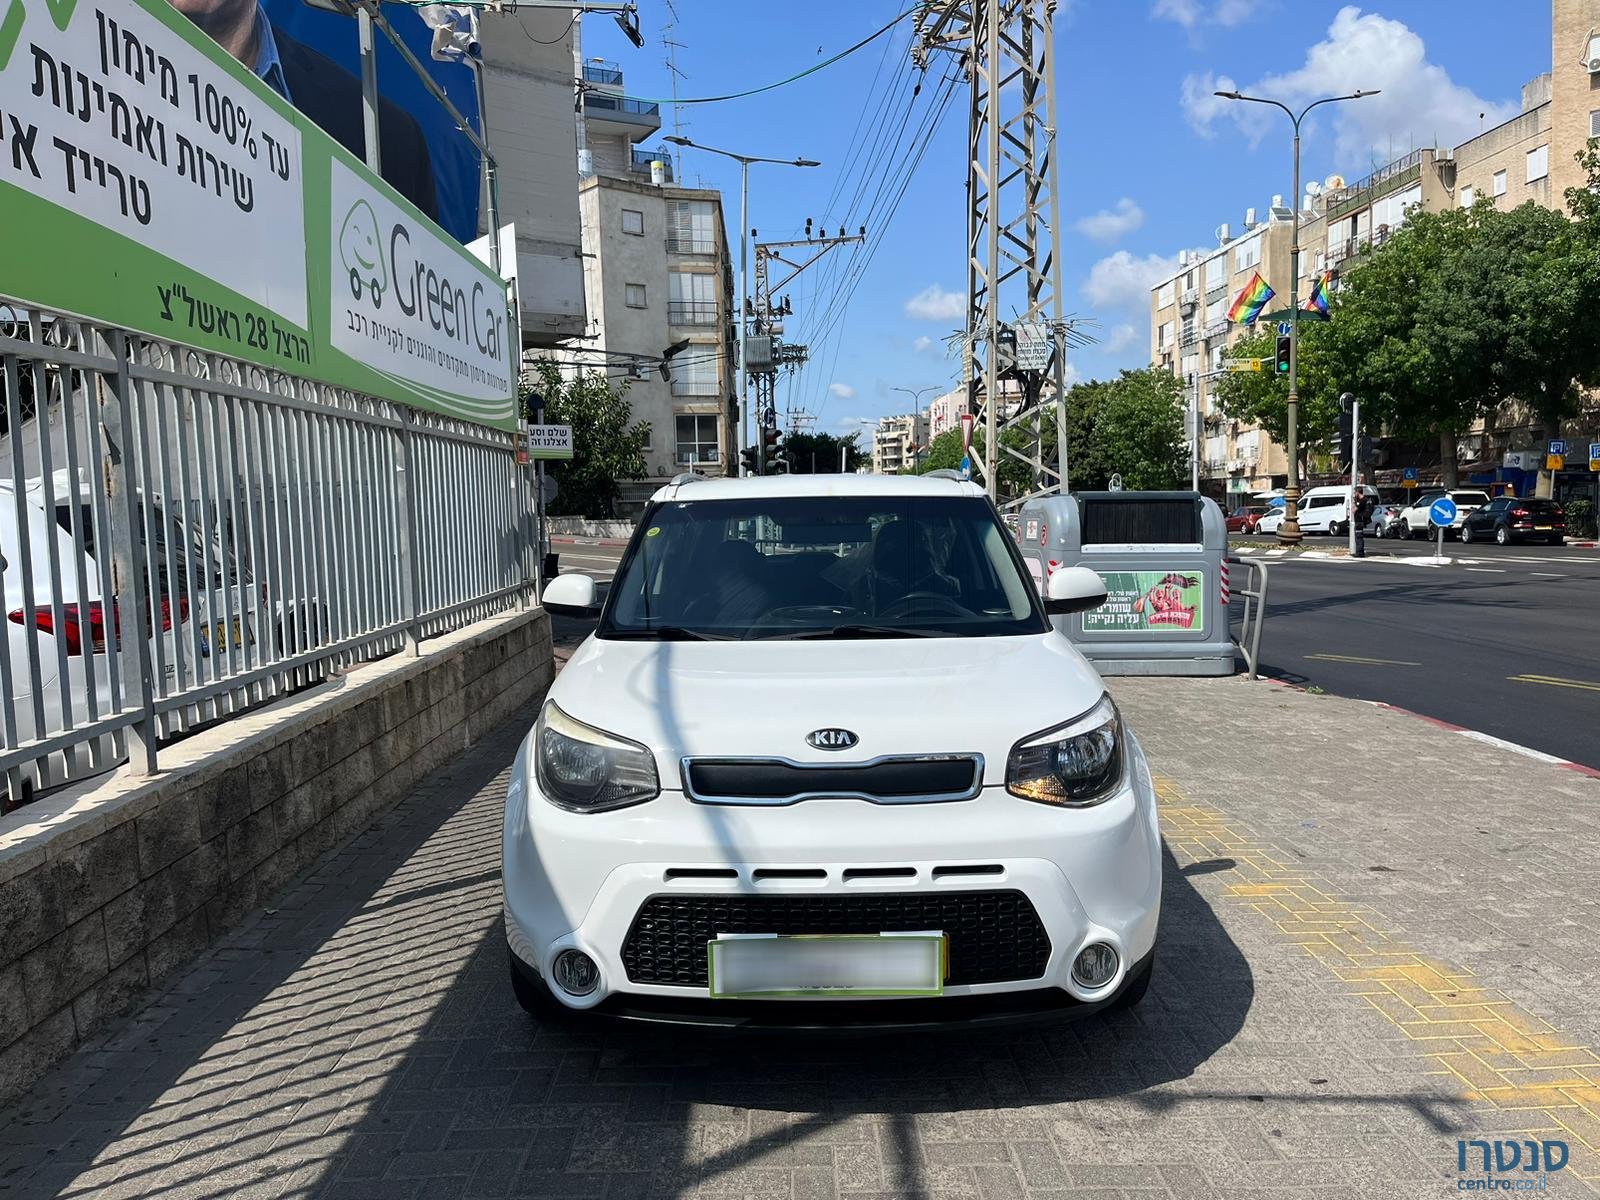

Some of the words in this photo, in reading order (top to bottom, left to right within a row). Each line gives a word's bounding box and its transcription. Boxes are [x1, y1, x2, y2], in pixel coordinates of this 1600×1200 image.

[96, 8, 179, 108] מימון
[30, 43, 168, 167] ואמינות
[188, 74, 257, 160] 100%
[176, 133, 254, 213] שירות
[262, 131, 290, 181] עד
[53, 136, 151, 226] טרייד
[391, 223, 469, 345] Green
[472, 281, 501, 361] Car
[245, 312, 268, 350] 28
[347, 309, 369, 336] רכב
[371, 320, 403, 353] לקניית
[272, 320, 310, 364] הרצל
[407, 336, 436, 364] והוגנים
[529, 428, 545, 436] וסע
[531, 438, 542, 446] זה
[543, 438, 568, 446] אצלנו
[548, 428, 567, 436] שלם
[1117, 613, 1139, 624] עליה
[814, 731, 852, 744] KIA
